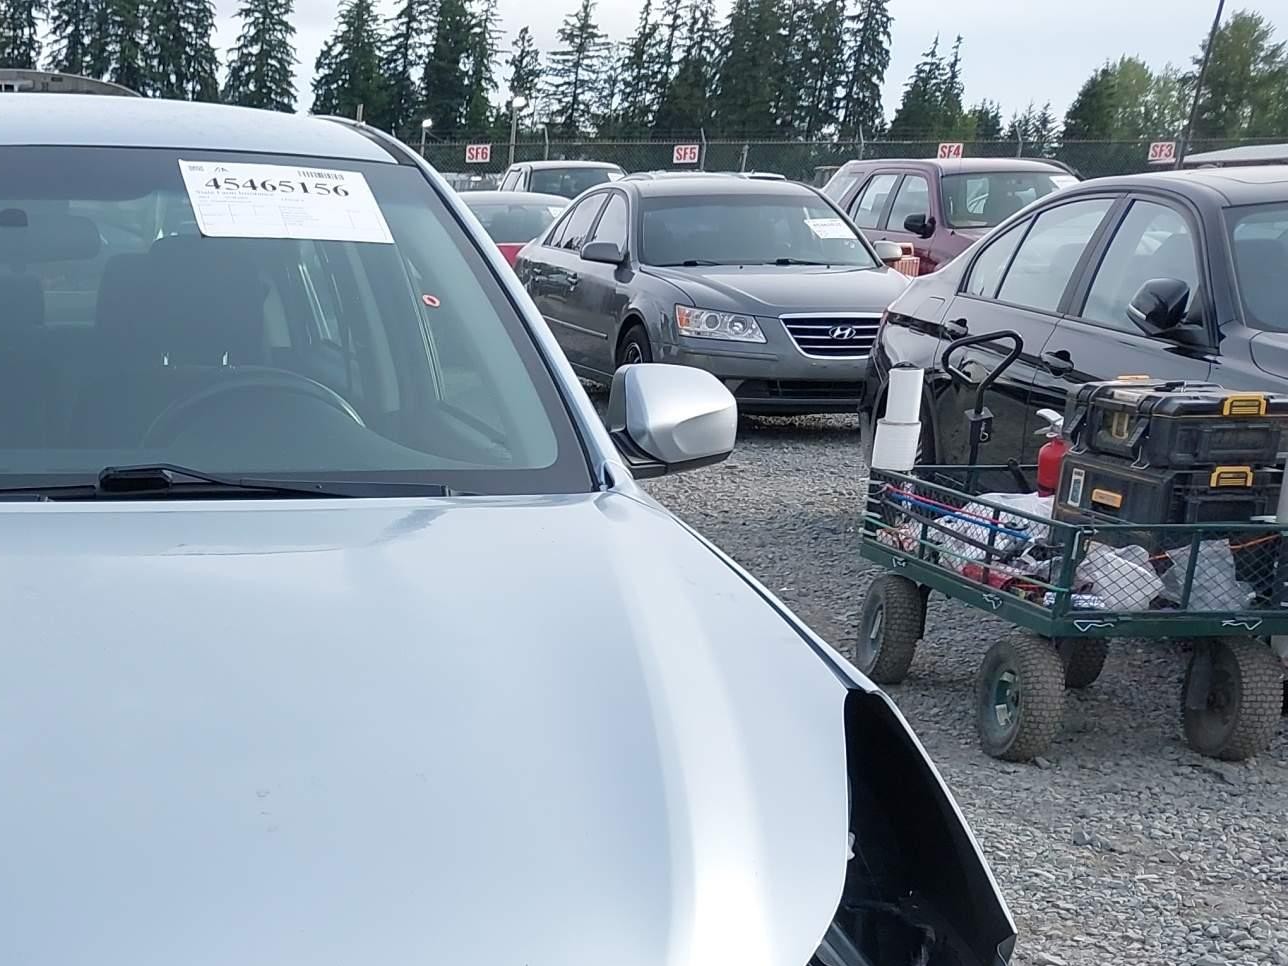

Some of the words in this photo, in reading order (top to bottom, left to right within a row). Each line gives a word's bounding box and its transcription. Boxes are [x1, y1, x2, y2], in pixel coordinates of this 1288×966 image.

[467, 146, 489, 161] SF6
[675, 146, 697, 161] SF5
[939, 144, 961, 159] SF4
[1150, 144, 1174, 158] SF3
[204, 176, 350, 198] 45465156
